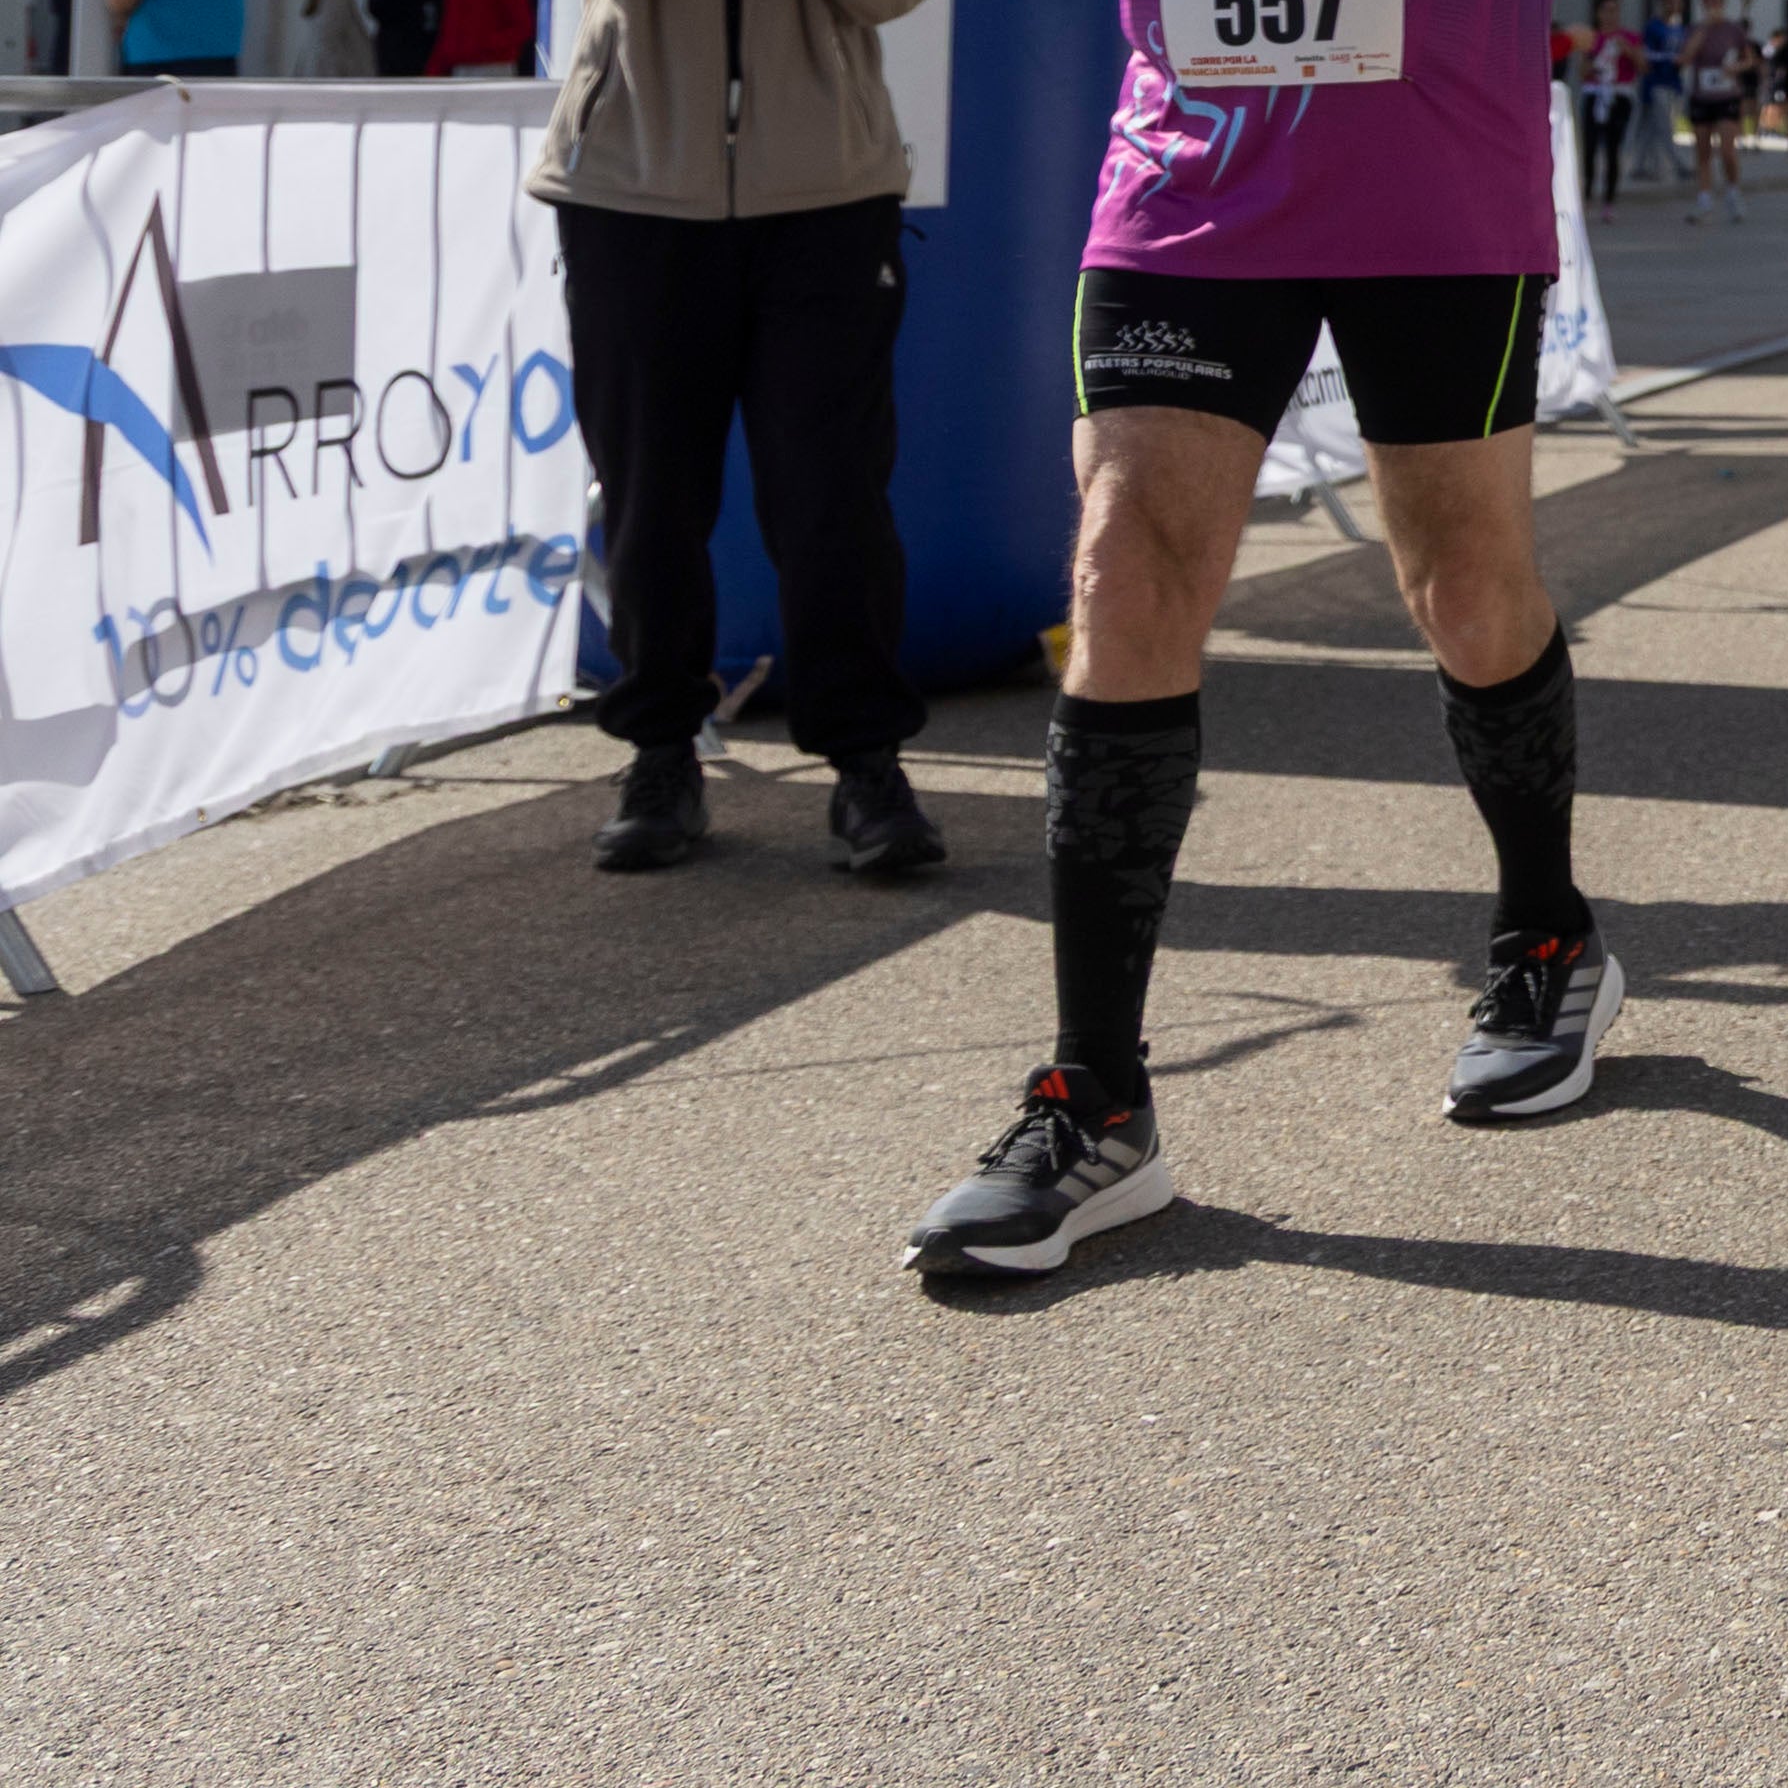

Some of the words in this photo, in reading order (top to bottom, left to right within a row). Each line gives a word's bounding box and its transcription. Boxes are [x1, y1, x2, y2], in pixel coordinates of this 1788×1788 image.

[1085, 358, 1139, 370] ATLETAS
[1142, 358, 1233, 380] POPULARES
[276, 523, 580, 672] deporte
